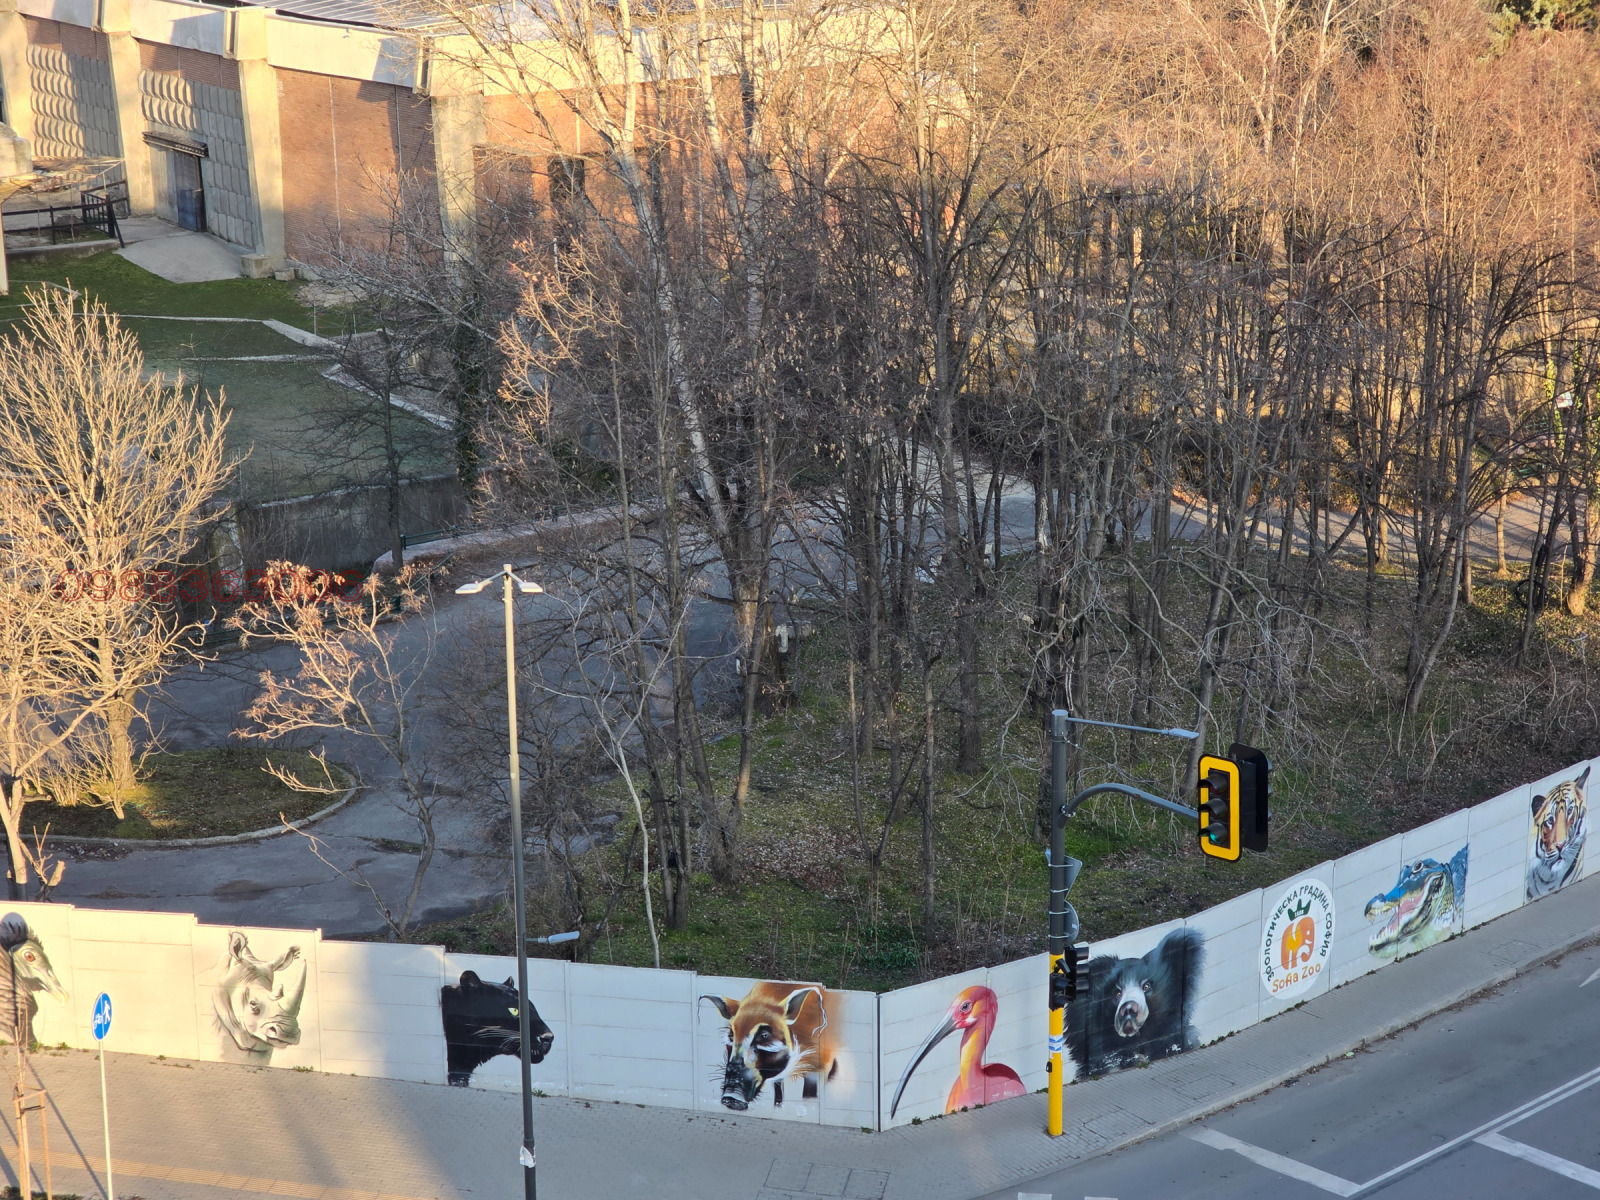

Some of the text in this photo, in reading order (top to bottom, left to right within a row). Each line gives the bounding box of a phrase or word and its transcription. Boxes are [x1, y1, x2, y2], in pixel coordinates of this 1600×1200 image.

[1264, 885, 1332, 982] ЗООЛОГИЧЕСКА ГРАДИНА СОФИЯ
[1272, 963, 1321, 993] Sofia Zoo
